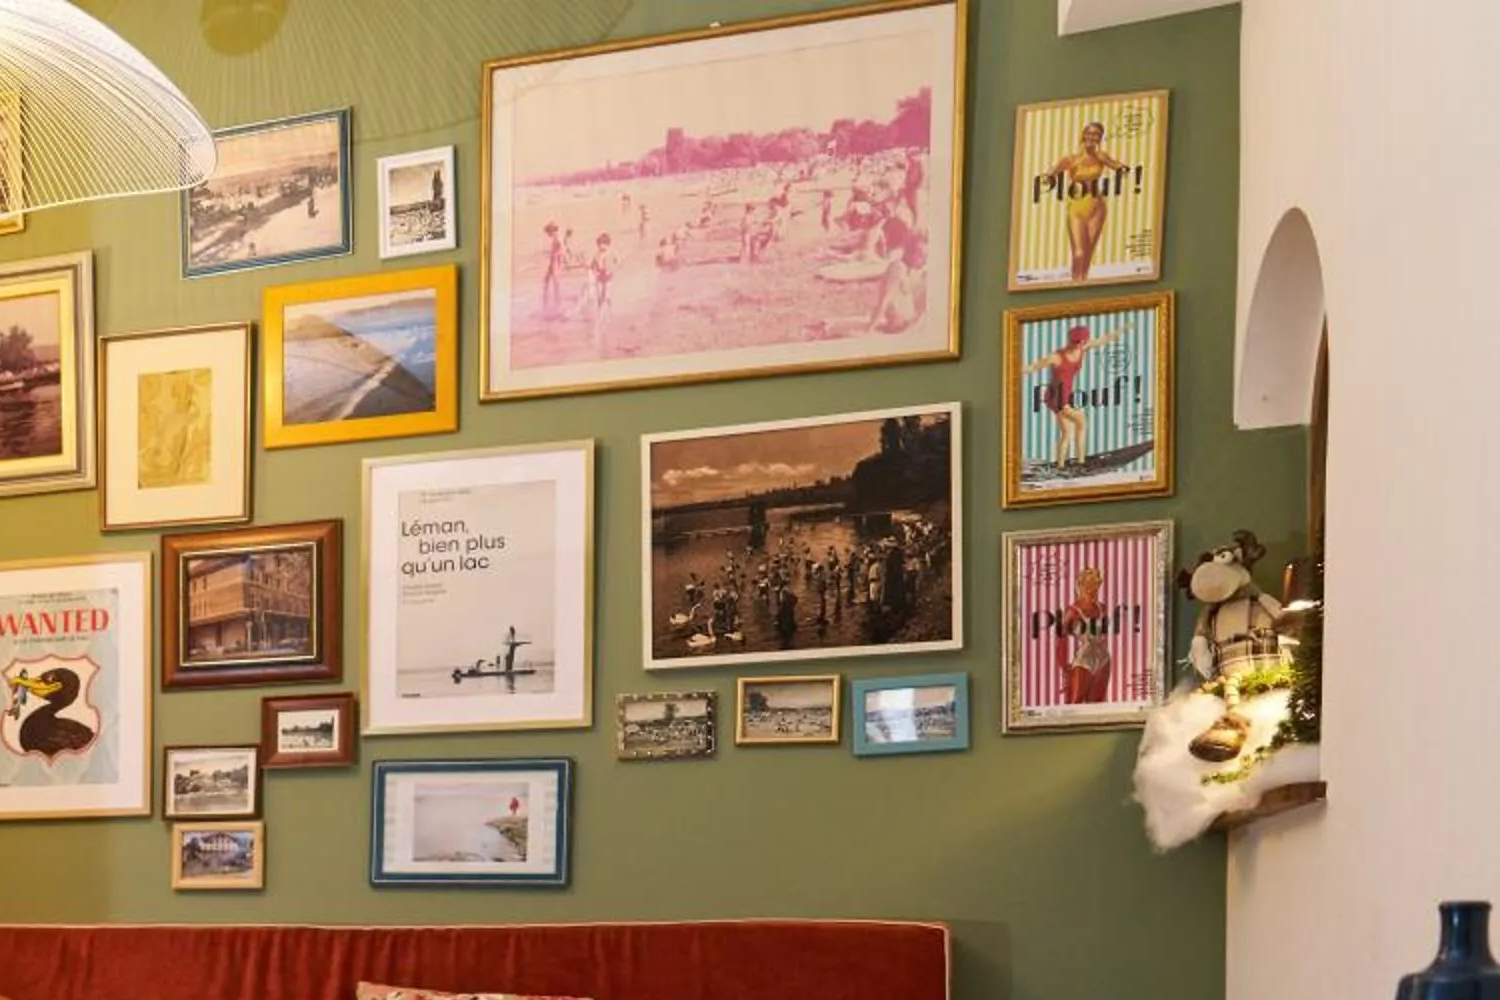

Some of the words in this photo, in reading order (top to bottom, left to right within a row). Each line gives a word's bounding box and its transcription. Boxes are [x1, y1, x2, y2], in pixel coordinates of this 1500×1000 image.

[419, 538, 460, 554] bien
[466, 534, 506, 554] plus
[401, 556, 456, 577] qu'un
[459, 555, 491, 571] lac
